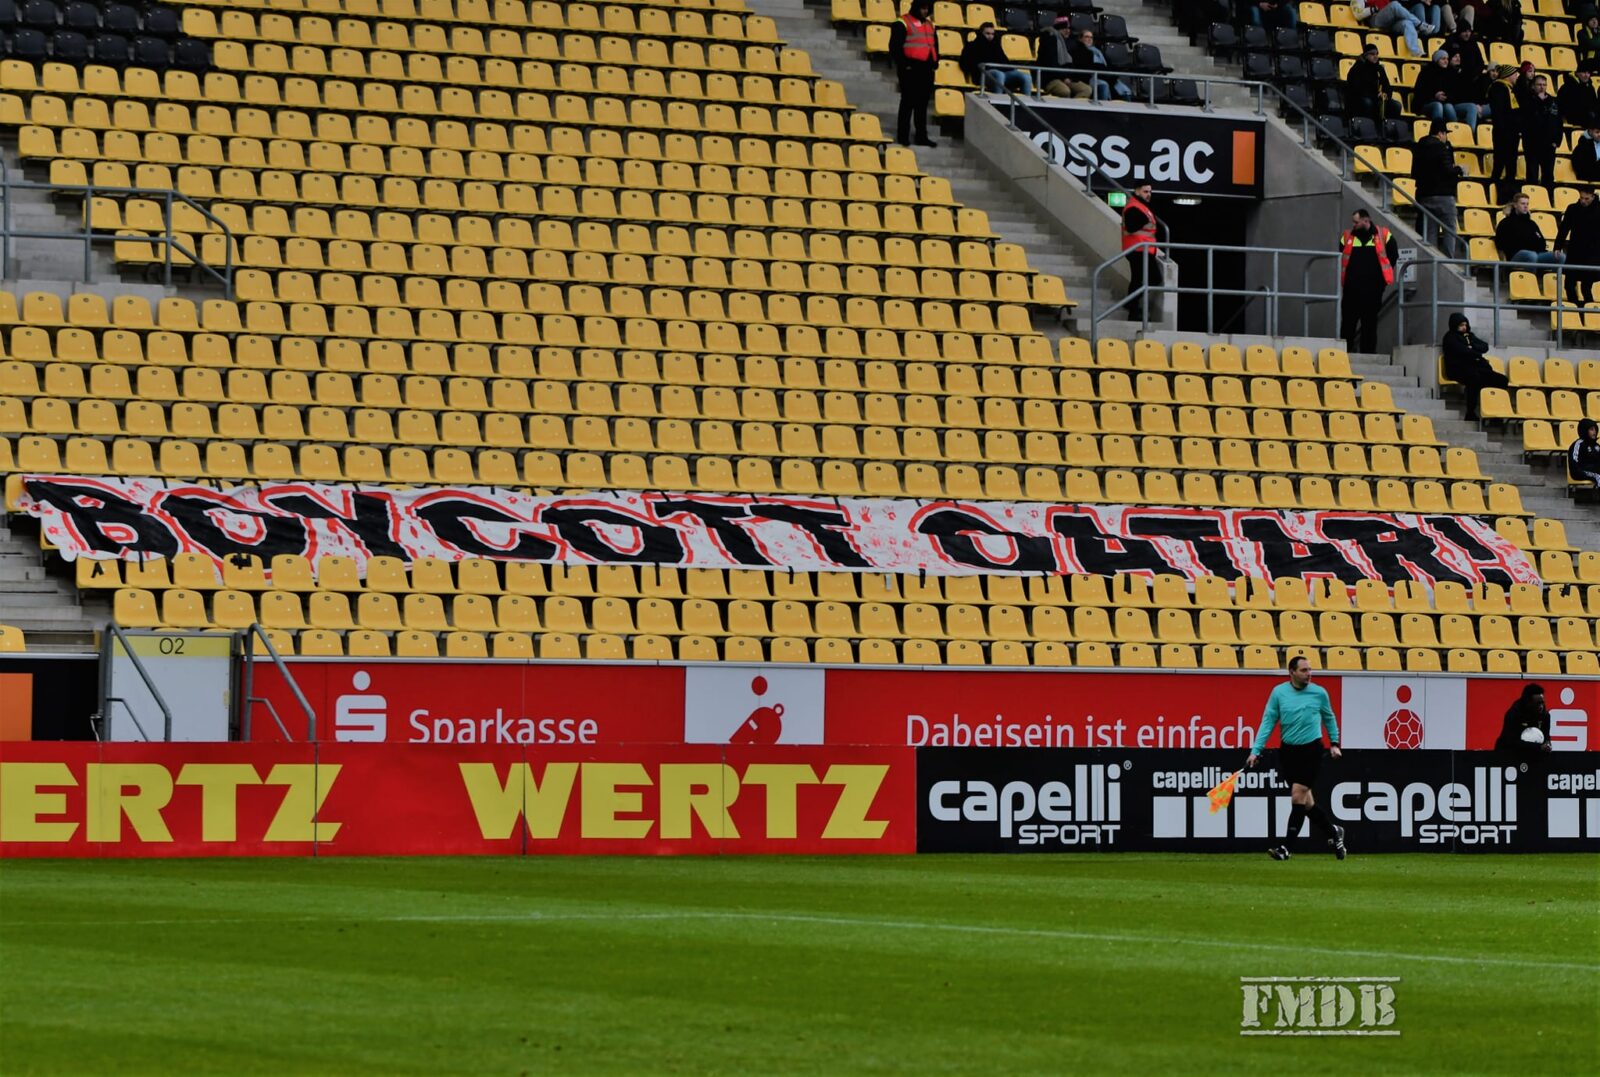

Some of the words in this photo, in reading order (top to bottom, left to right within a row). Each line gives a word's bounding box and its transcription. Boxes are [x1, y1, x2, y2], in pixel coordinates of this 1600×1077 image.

[1023, 131, 1215, 184] oss.ac
[408, 708, 598, 744] Sparkasse
[906, 714, 1075, 748] Dabeisein
[1086, 715, 1127, 748] ist
[1136, 716, 1254, 749] einfach
[458, 762, 890, 840] WERTZ
[1018, 824, 1121, 845] SPORT
[1419, 824, 1518, 845] SPORT
